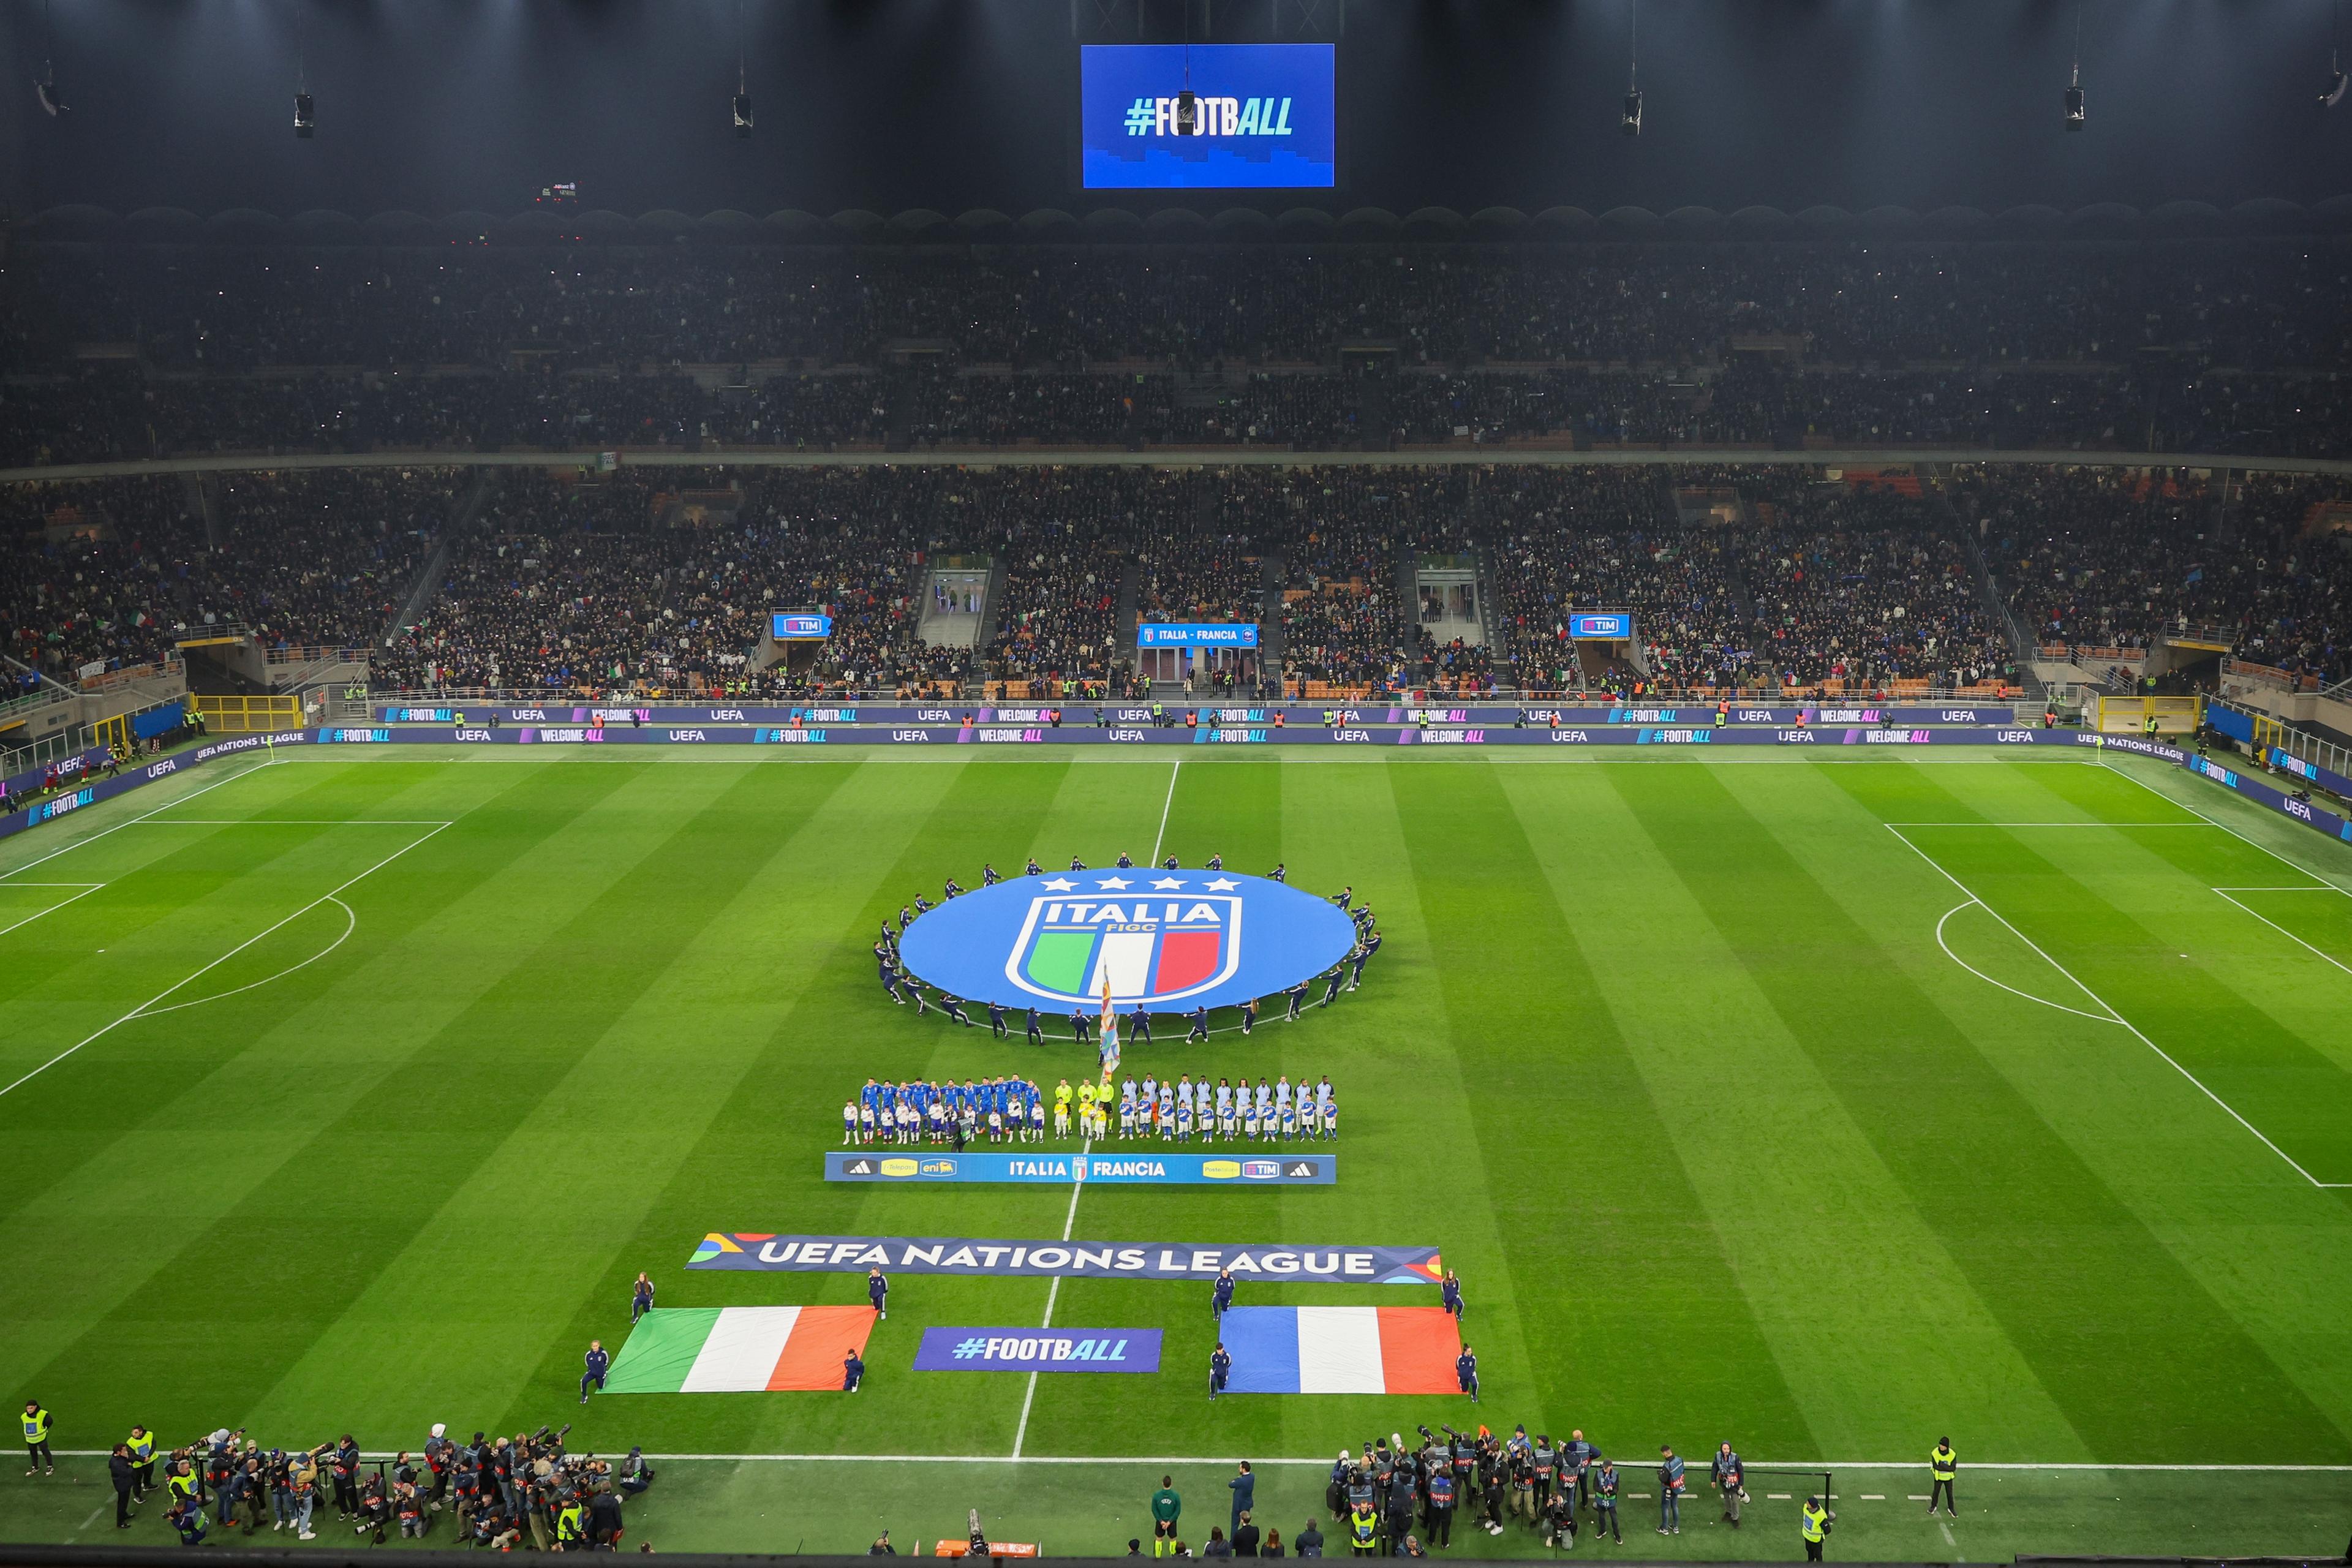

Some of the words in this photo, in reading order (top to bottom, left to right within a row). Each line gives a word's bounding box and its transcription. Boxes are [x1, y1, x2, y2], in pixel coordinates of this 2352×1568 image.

[799, 621, 818, 630] TIM
[1596, 621, 1615, 630] TIM
[1159, 630, 1188, 640] ITALIA
[1196, 630, 1237, 640] FRANCIA
[399, 709, 451, 721] #FOOTBALL
[512, 710, 546, 720] UEFA
[592, 709, 631, 721] WELCOME
[710, 710, 745, 720] UEFA
[804, 710, 856, 721] #FOOTBALL
[918, 710, 951, 721] UEFA
[998, 710, 1038, 722] WELCOME
[1038, 710, 1050, 722] AL
[1118, 710, 1152, 720] UEFA
[1408, 710, 1448, 722] WECOME
[1449, 710, 1466, 722] ALL
[1529, 710, 1562, 721] UEFA
[1623, 709, 1676, 722] #FOOTBALL
[1738, 711, 1772, 721] UEFA
[1820, 710, 1861, 722] WELCOME
[1861, 710, 1880, 722] ALL
[1942, 710, 1976, 721] UEFA
[334, 729, 390, 742] #FOOTBALL
[455, 730, 491, 741] UEFA
[540, 729, 584, 742] WELCOME
[584, 729, 604, 742] ALL
[669, 730, 706, 741] UEFA
[770, 730, 826, 742] #FOOTBALL
[893, 731, 929, 741] UEFA
[979, 729, 1022, 742] WELCOME
[1022, 729, 1042, 742] ALL
[1109, 730, 1145, 741] UEFA
[1209, 729, 1267, 742] #FOOTBALL
[1334, 731, 1370, 742] UEFA
[1421, 730, 1464, 743] WELCOME
[1464, 730, 1484, 743] ALL
[1551, 731, 1588, 742] UEFA
[1653, 730, 1711, 742] #FOOTBALL
[1778, 731, 1814, 742] UEFA
[1866, 731, 1910, 743] WELCOME
[1910, 731, 1930, 743] ALL
[1997, 731, 2034, 742] UEFA
[197, 745, 216, 759] UEFA
[217, 736, 257, 752] NATIONS
[2108, 737, 2152, 752] NATIONS
[2154, 746, 2184, 761] LEAGUE
[148, 760, 176, 778] UEFA
[2281, 753, 2318, 780] #FOOTBALL
[2199, 760, 2239, 788] #FOOTBALL
[42, 788, 94, 819] #FOOTBALL
[2283, 797, 2312, 821] UEFA
[1045, 902, 1221, 923] ITALIA
[1105, 924, 1158, 932] FIGC
[922, 1163, 940, 1172] eni
[1009, 1161, 1067, 1176] ITALIA
[1093, 1162, 1166, 1177] FRANCIA
[1257, 1165, 1276, 1175] TIM
[758, 1242, 891, 1265] UEFA
[900, 1244, 1147, 1270] NATIONS
[1158, 1250, 1374, 1275] LEAGUE
[951, 1338, 1129, 1361] #FOOTBALL
